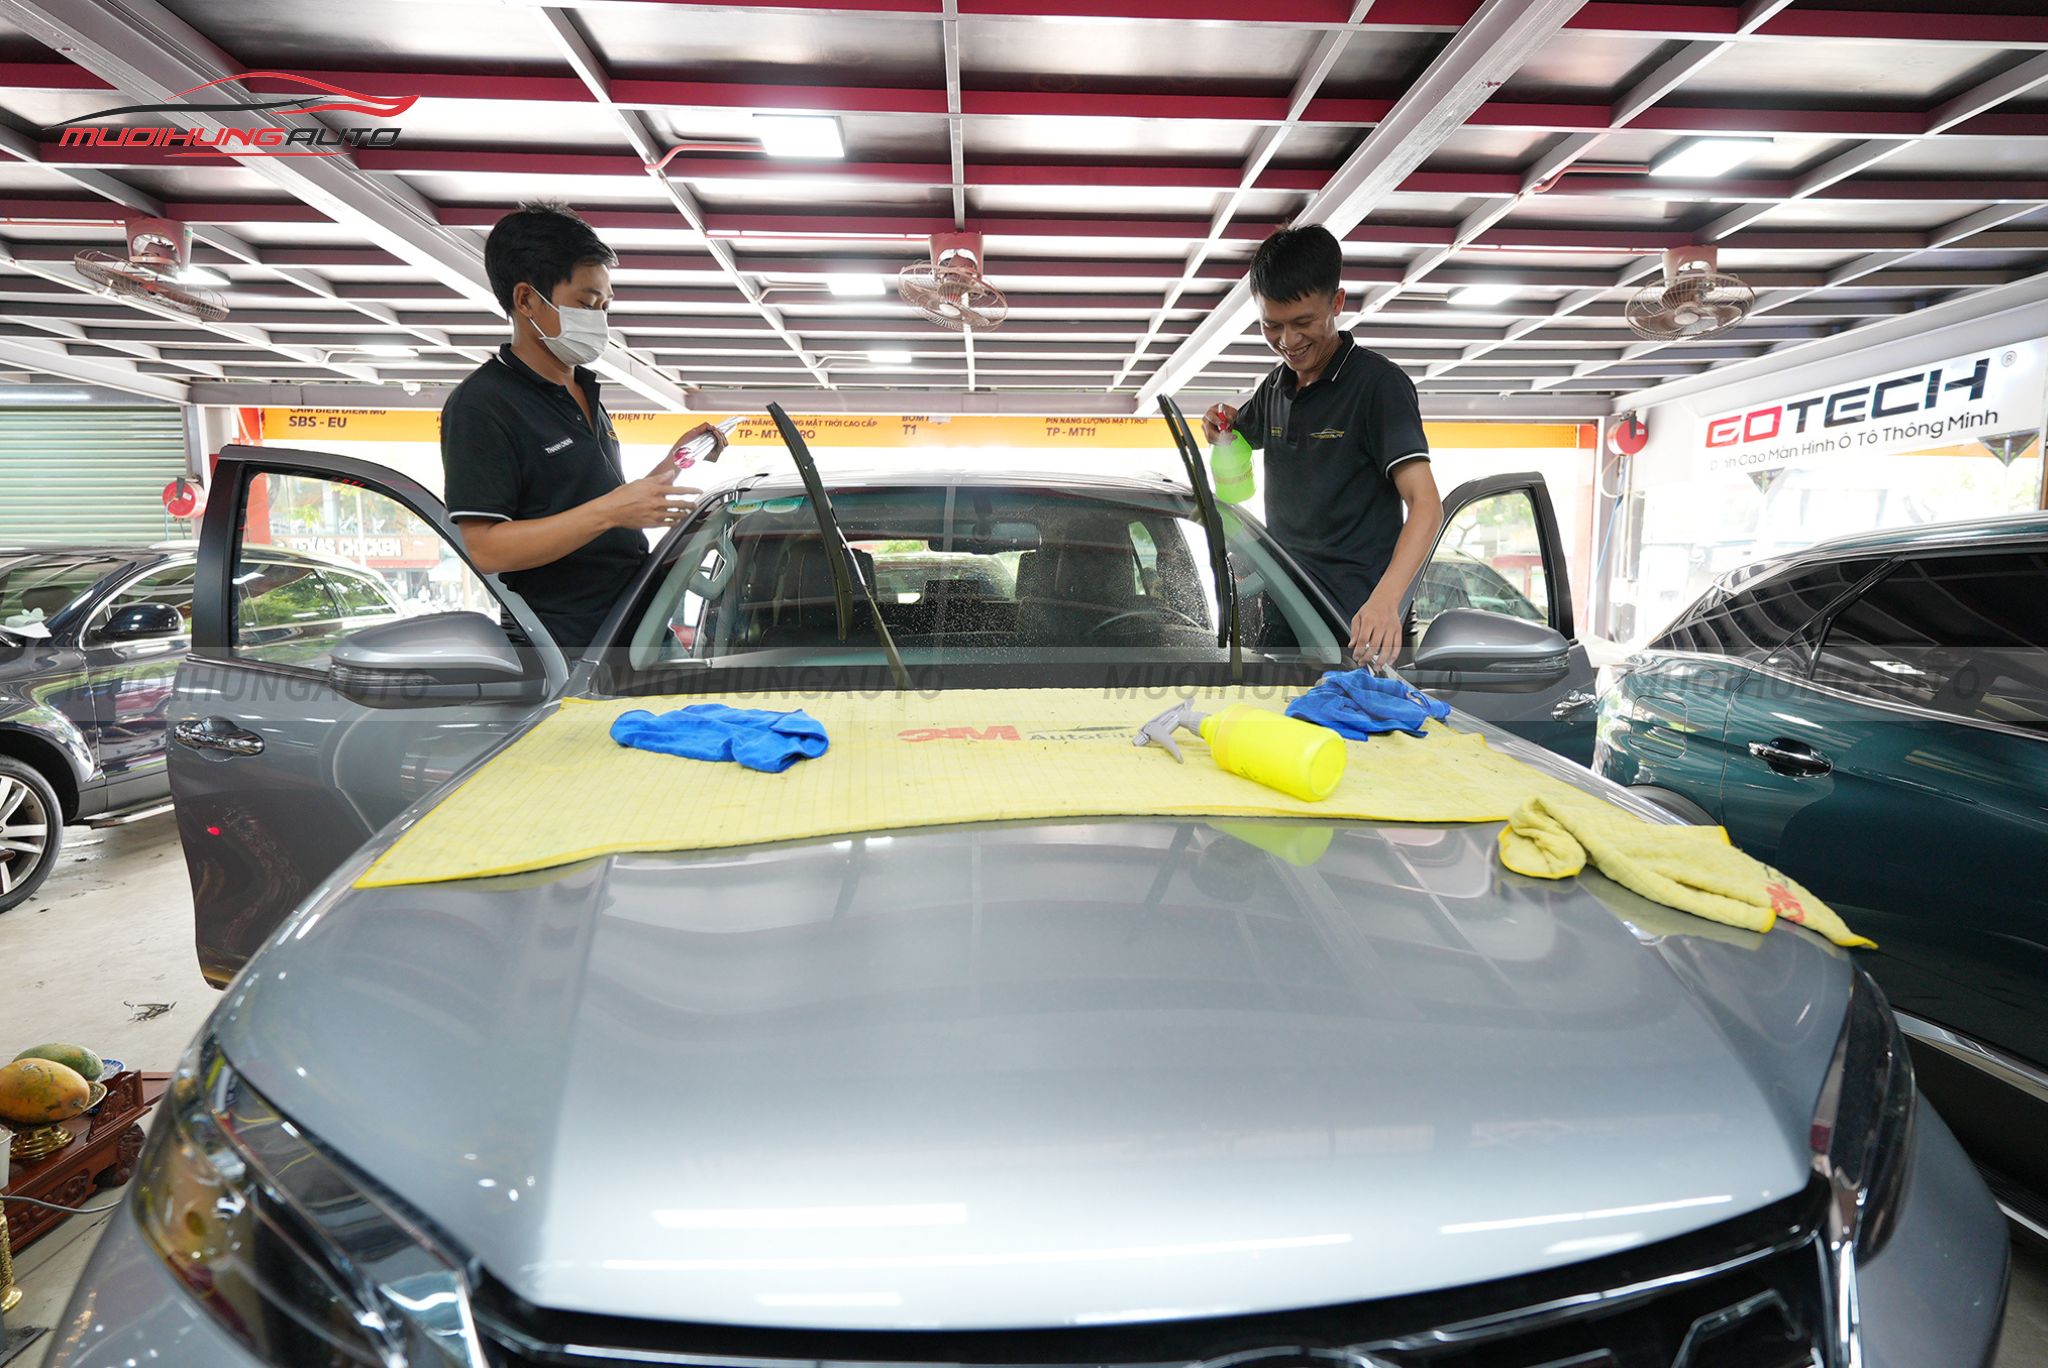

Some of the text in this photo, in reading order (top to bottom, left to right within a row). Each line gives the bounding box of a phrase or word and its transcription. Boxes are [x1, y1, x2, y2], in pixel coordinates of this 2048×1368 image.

[1705, 358, 1991, 448] GOTECH
[288, 415, 317, 428] SBS
[327, 416, 347, 428] EU
[843, 419, 860, 428] CAO
[738, 428, 753, 439] TP
[902, 424, 917, 435] T1
[1045, 427, 1060, 437] TP
[1068, 427, 1096, 437] MT11
[1739, 453, 1766, 467] Cao
[1883, 420, 1944, 441] Thông
[1948, 409, 1998, 432] Minh
[896, 725, 1021, 743] 3M
